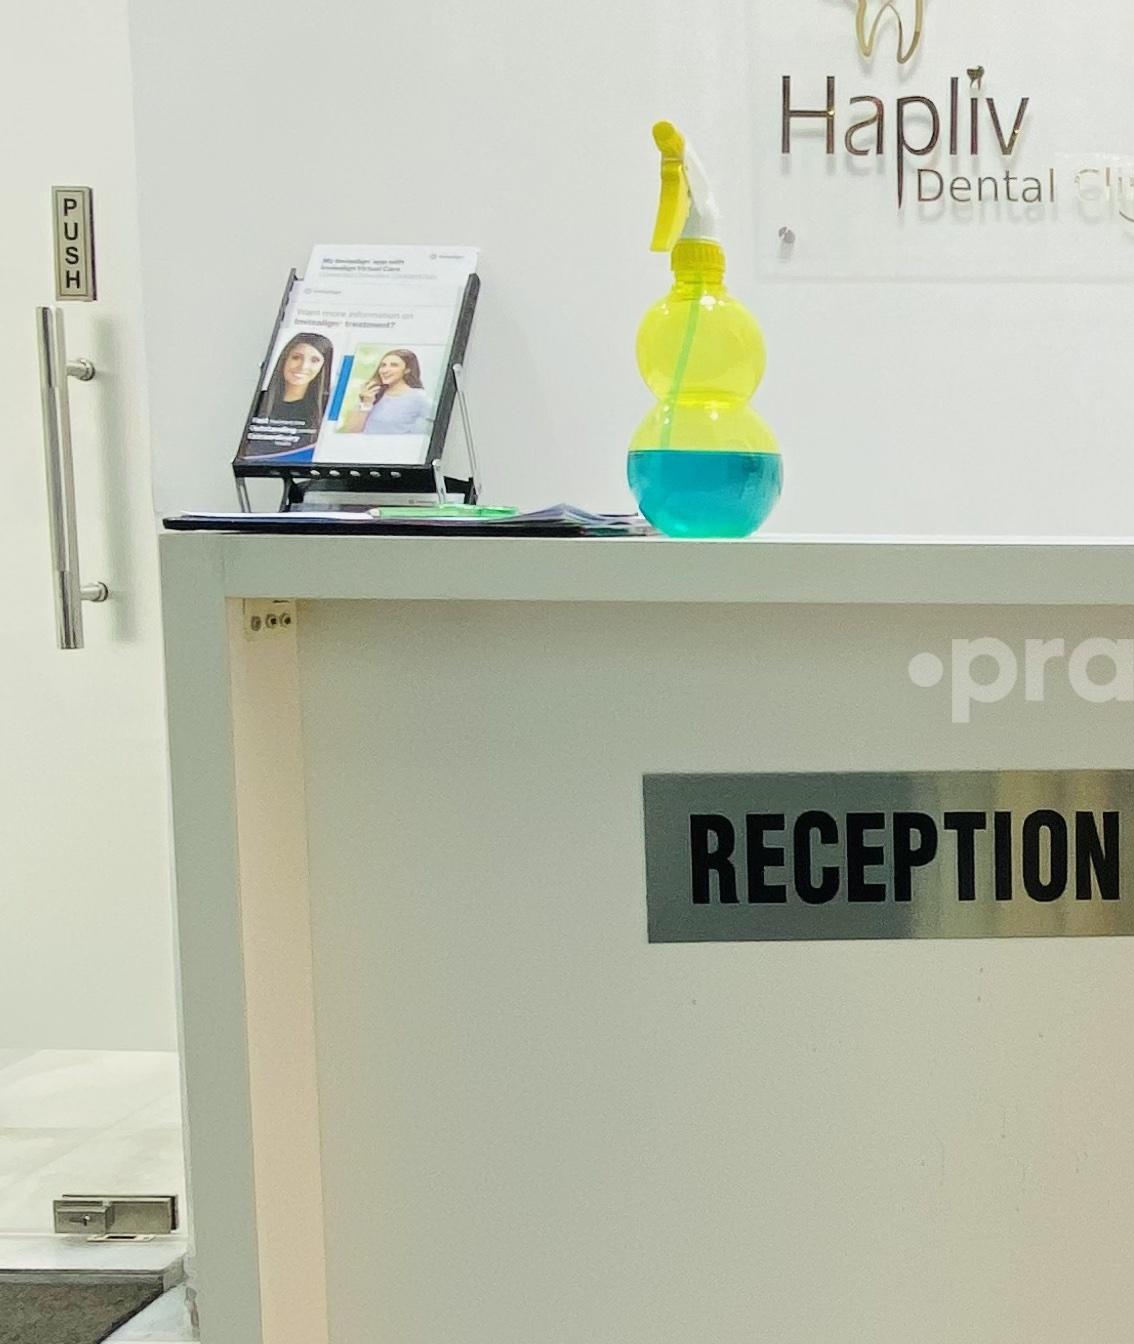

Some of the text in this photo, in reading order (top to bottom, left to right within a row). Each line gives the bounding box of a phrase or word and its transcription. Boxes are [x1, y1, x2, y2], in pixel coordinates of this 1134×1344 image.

[780, 66, 1030, 209] Hapliv
[916, 168, 1056, 203] Dental
[63, 198, 81, 289] PUSH
[690, 810, 1121, 906] RECEPTION
